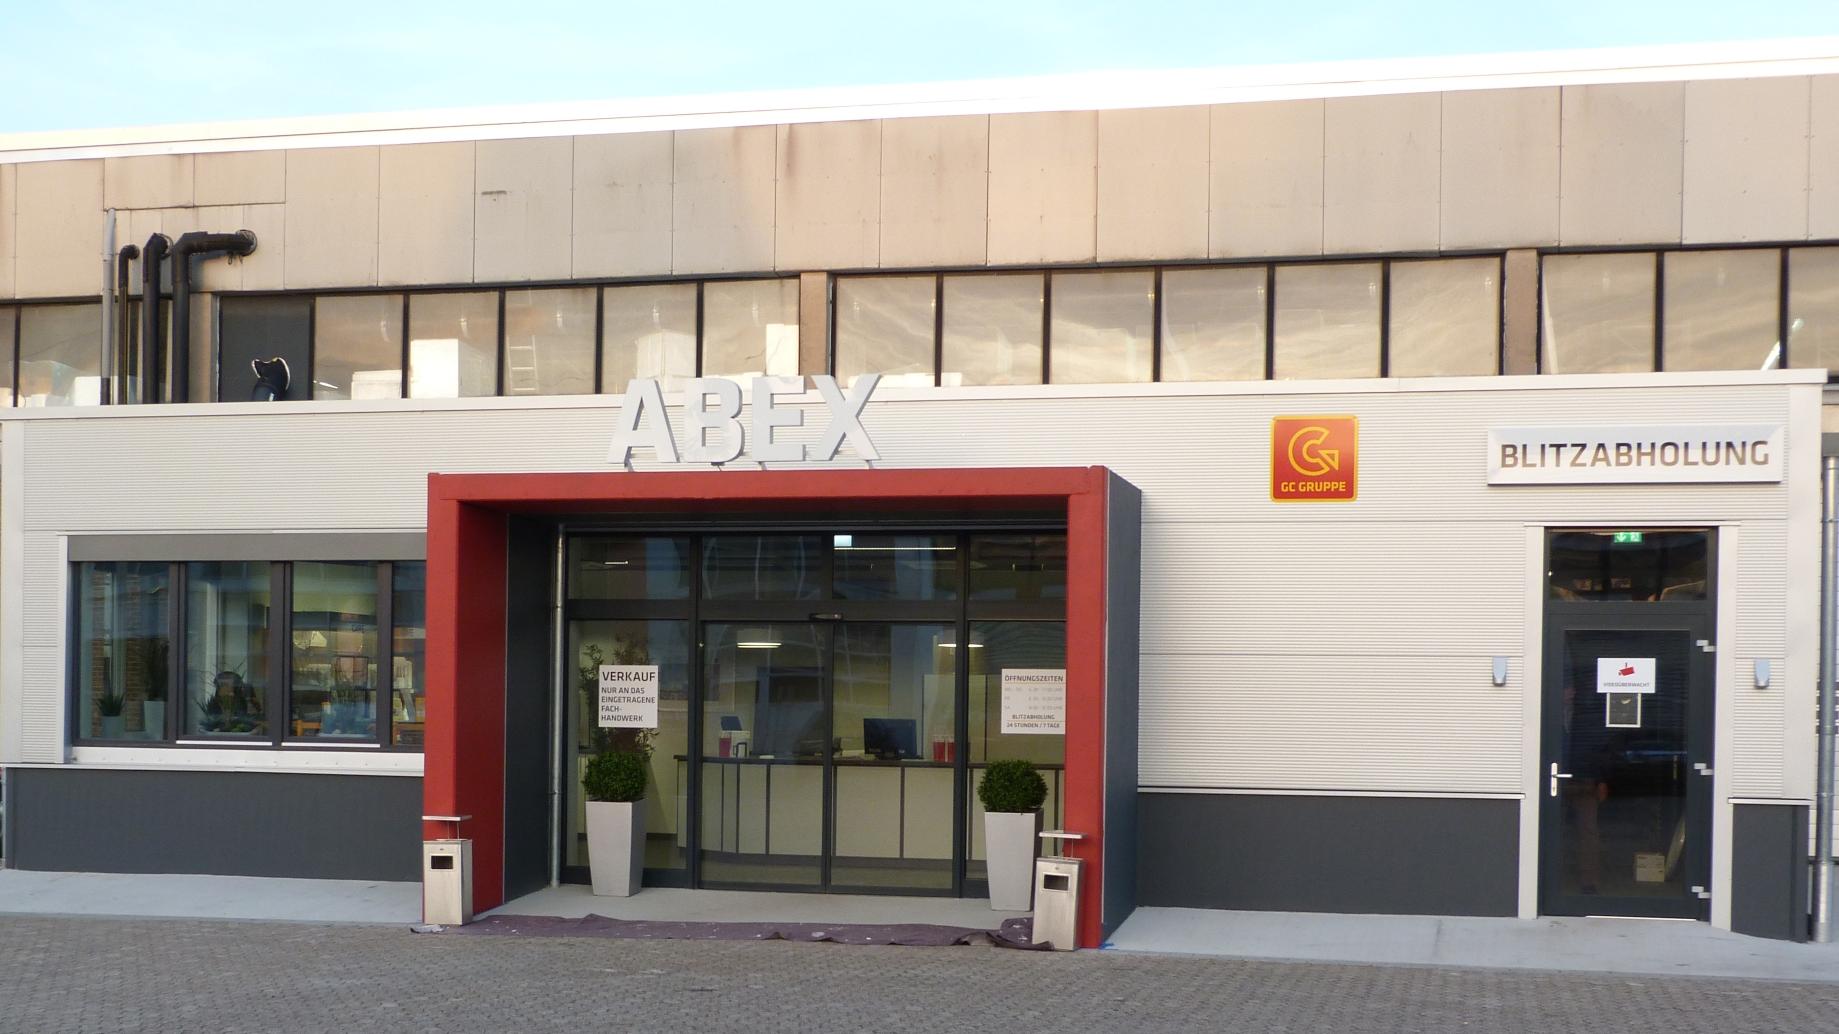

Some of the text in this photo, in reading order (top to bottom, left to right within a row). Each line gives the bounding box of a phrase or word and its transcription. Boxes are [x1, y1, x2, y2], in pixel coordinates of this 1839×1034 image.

[606, 374, 883, 464] ABEX
[1500, 440, 1770, 468] BLITZABHOLUNG
[1281, 481, 1346, 492] GC GRUPPE
[602, 671, 656, 682] VERKAUF
[631, 687, 645, 695] DAS
[601, 696, 656, 704] EINGETRAGENE
[601, 705, 623, 713] FACH-
[601, 714, 644, 722] HANDWERK
